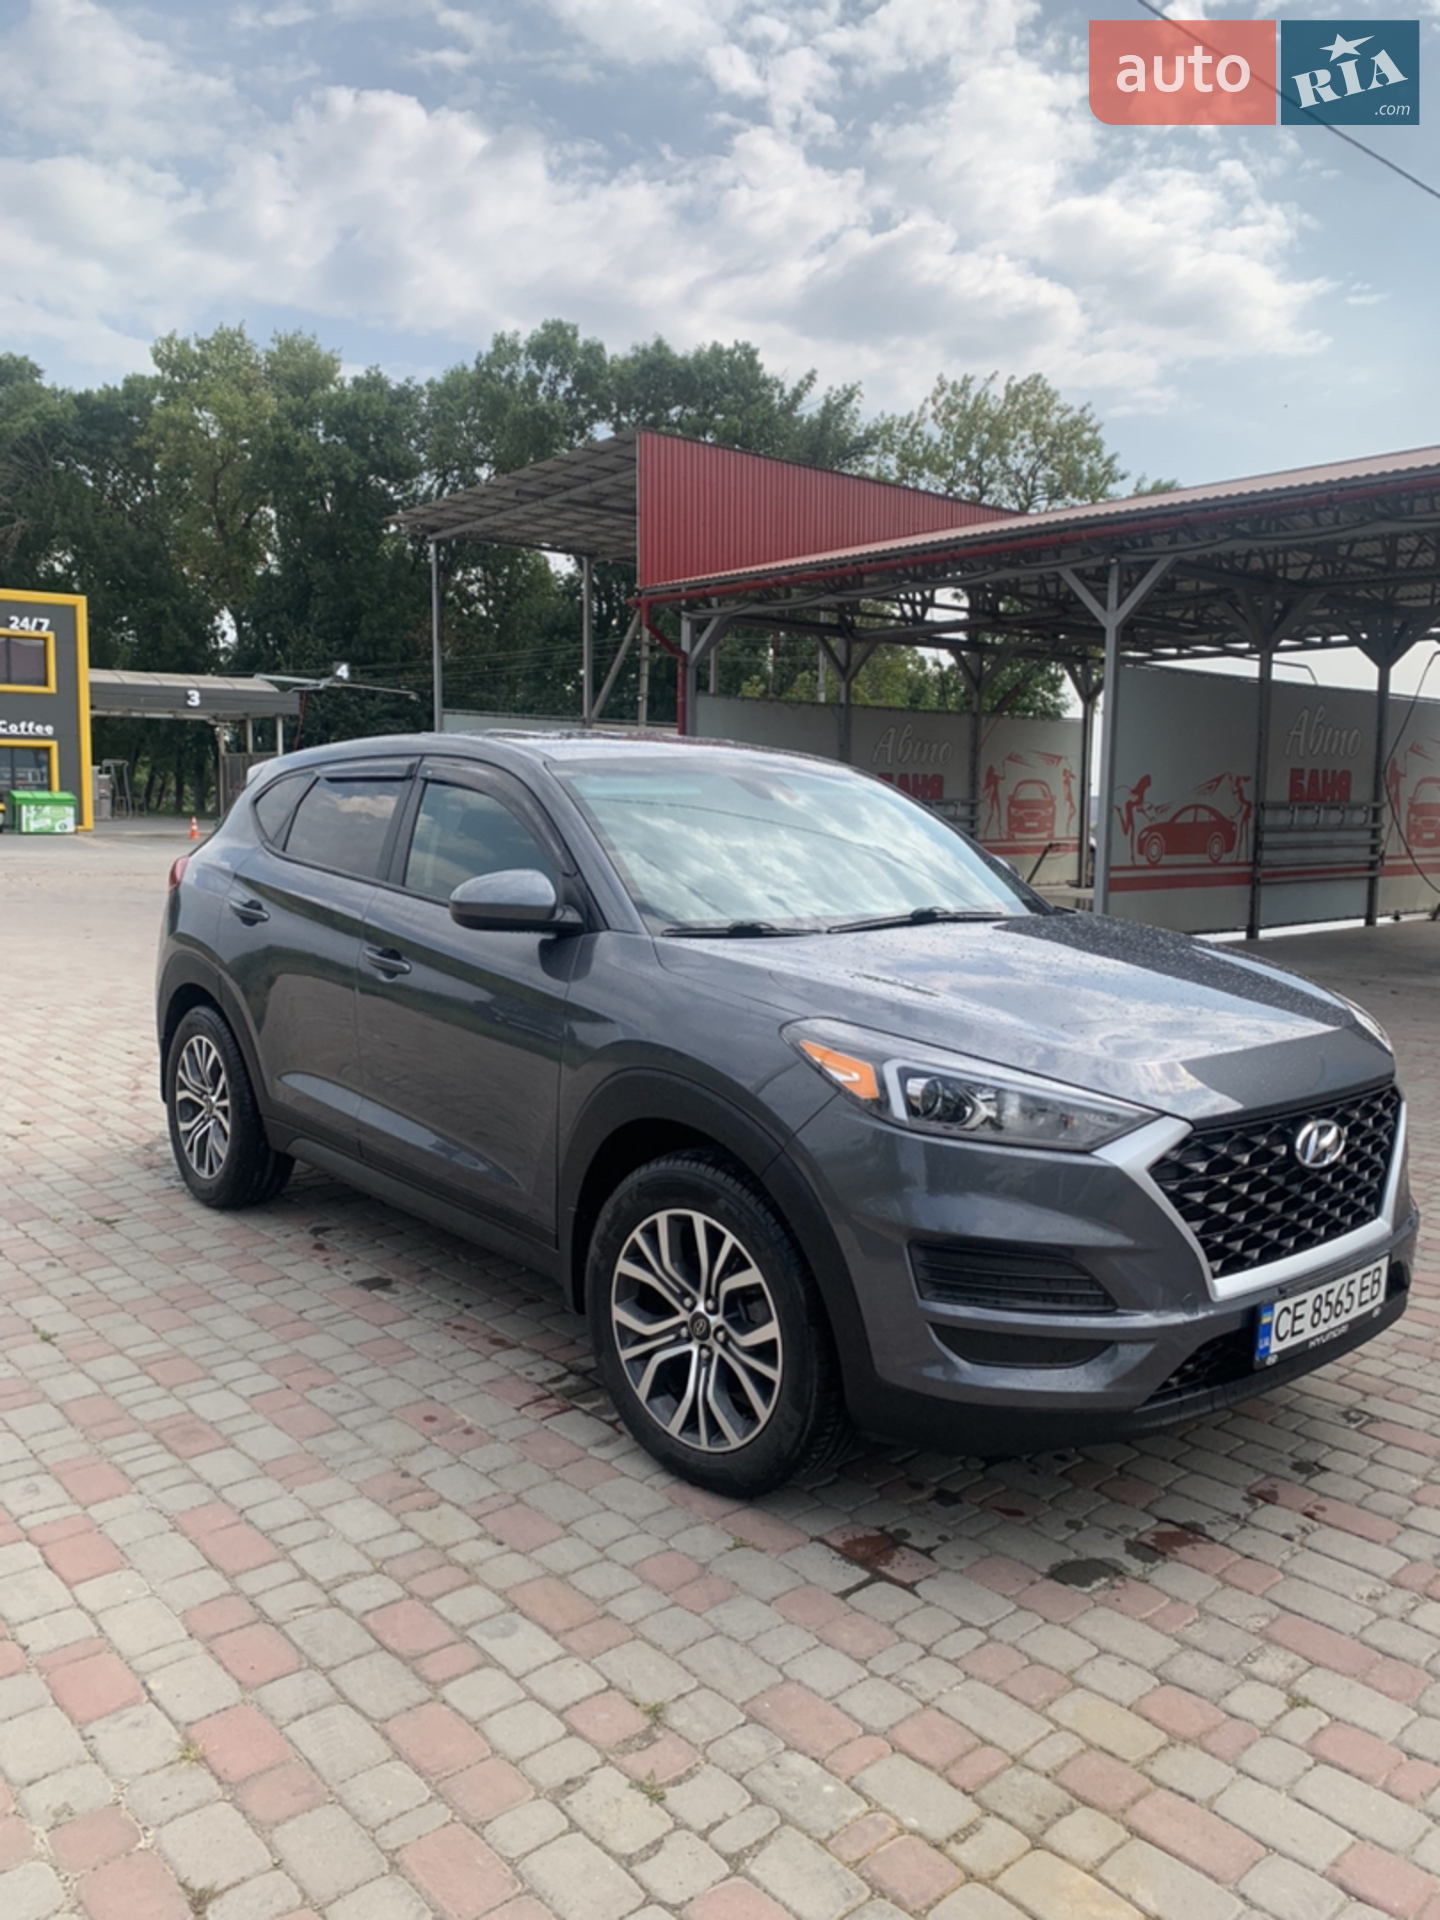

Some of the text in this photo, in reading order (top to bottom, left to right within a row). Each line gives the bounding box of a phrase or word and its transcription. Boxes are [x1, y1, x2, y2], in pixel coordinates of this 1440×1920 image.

[9, 615, 50, 632] 24/7
[335, 663, 350, 680] 4
[186, 689, 201, 707] 3
[0, 720, 54, 736] Coffee
[1288, 767, 1352, 803] БАНЯ
[1274, 1265, 1382, 1343] CE 8565 EB
